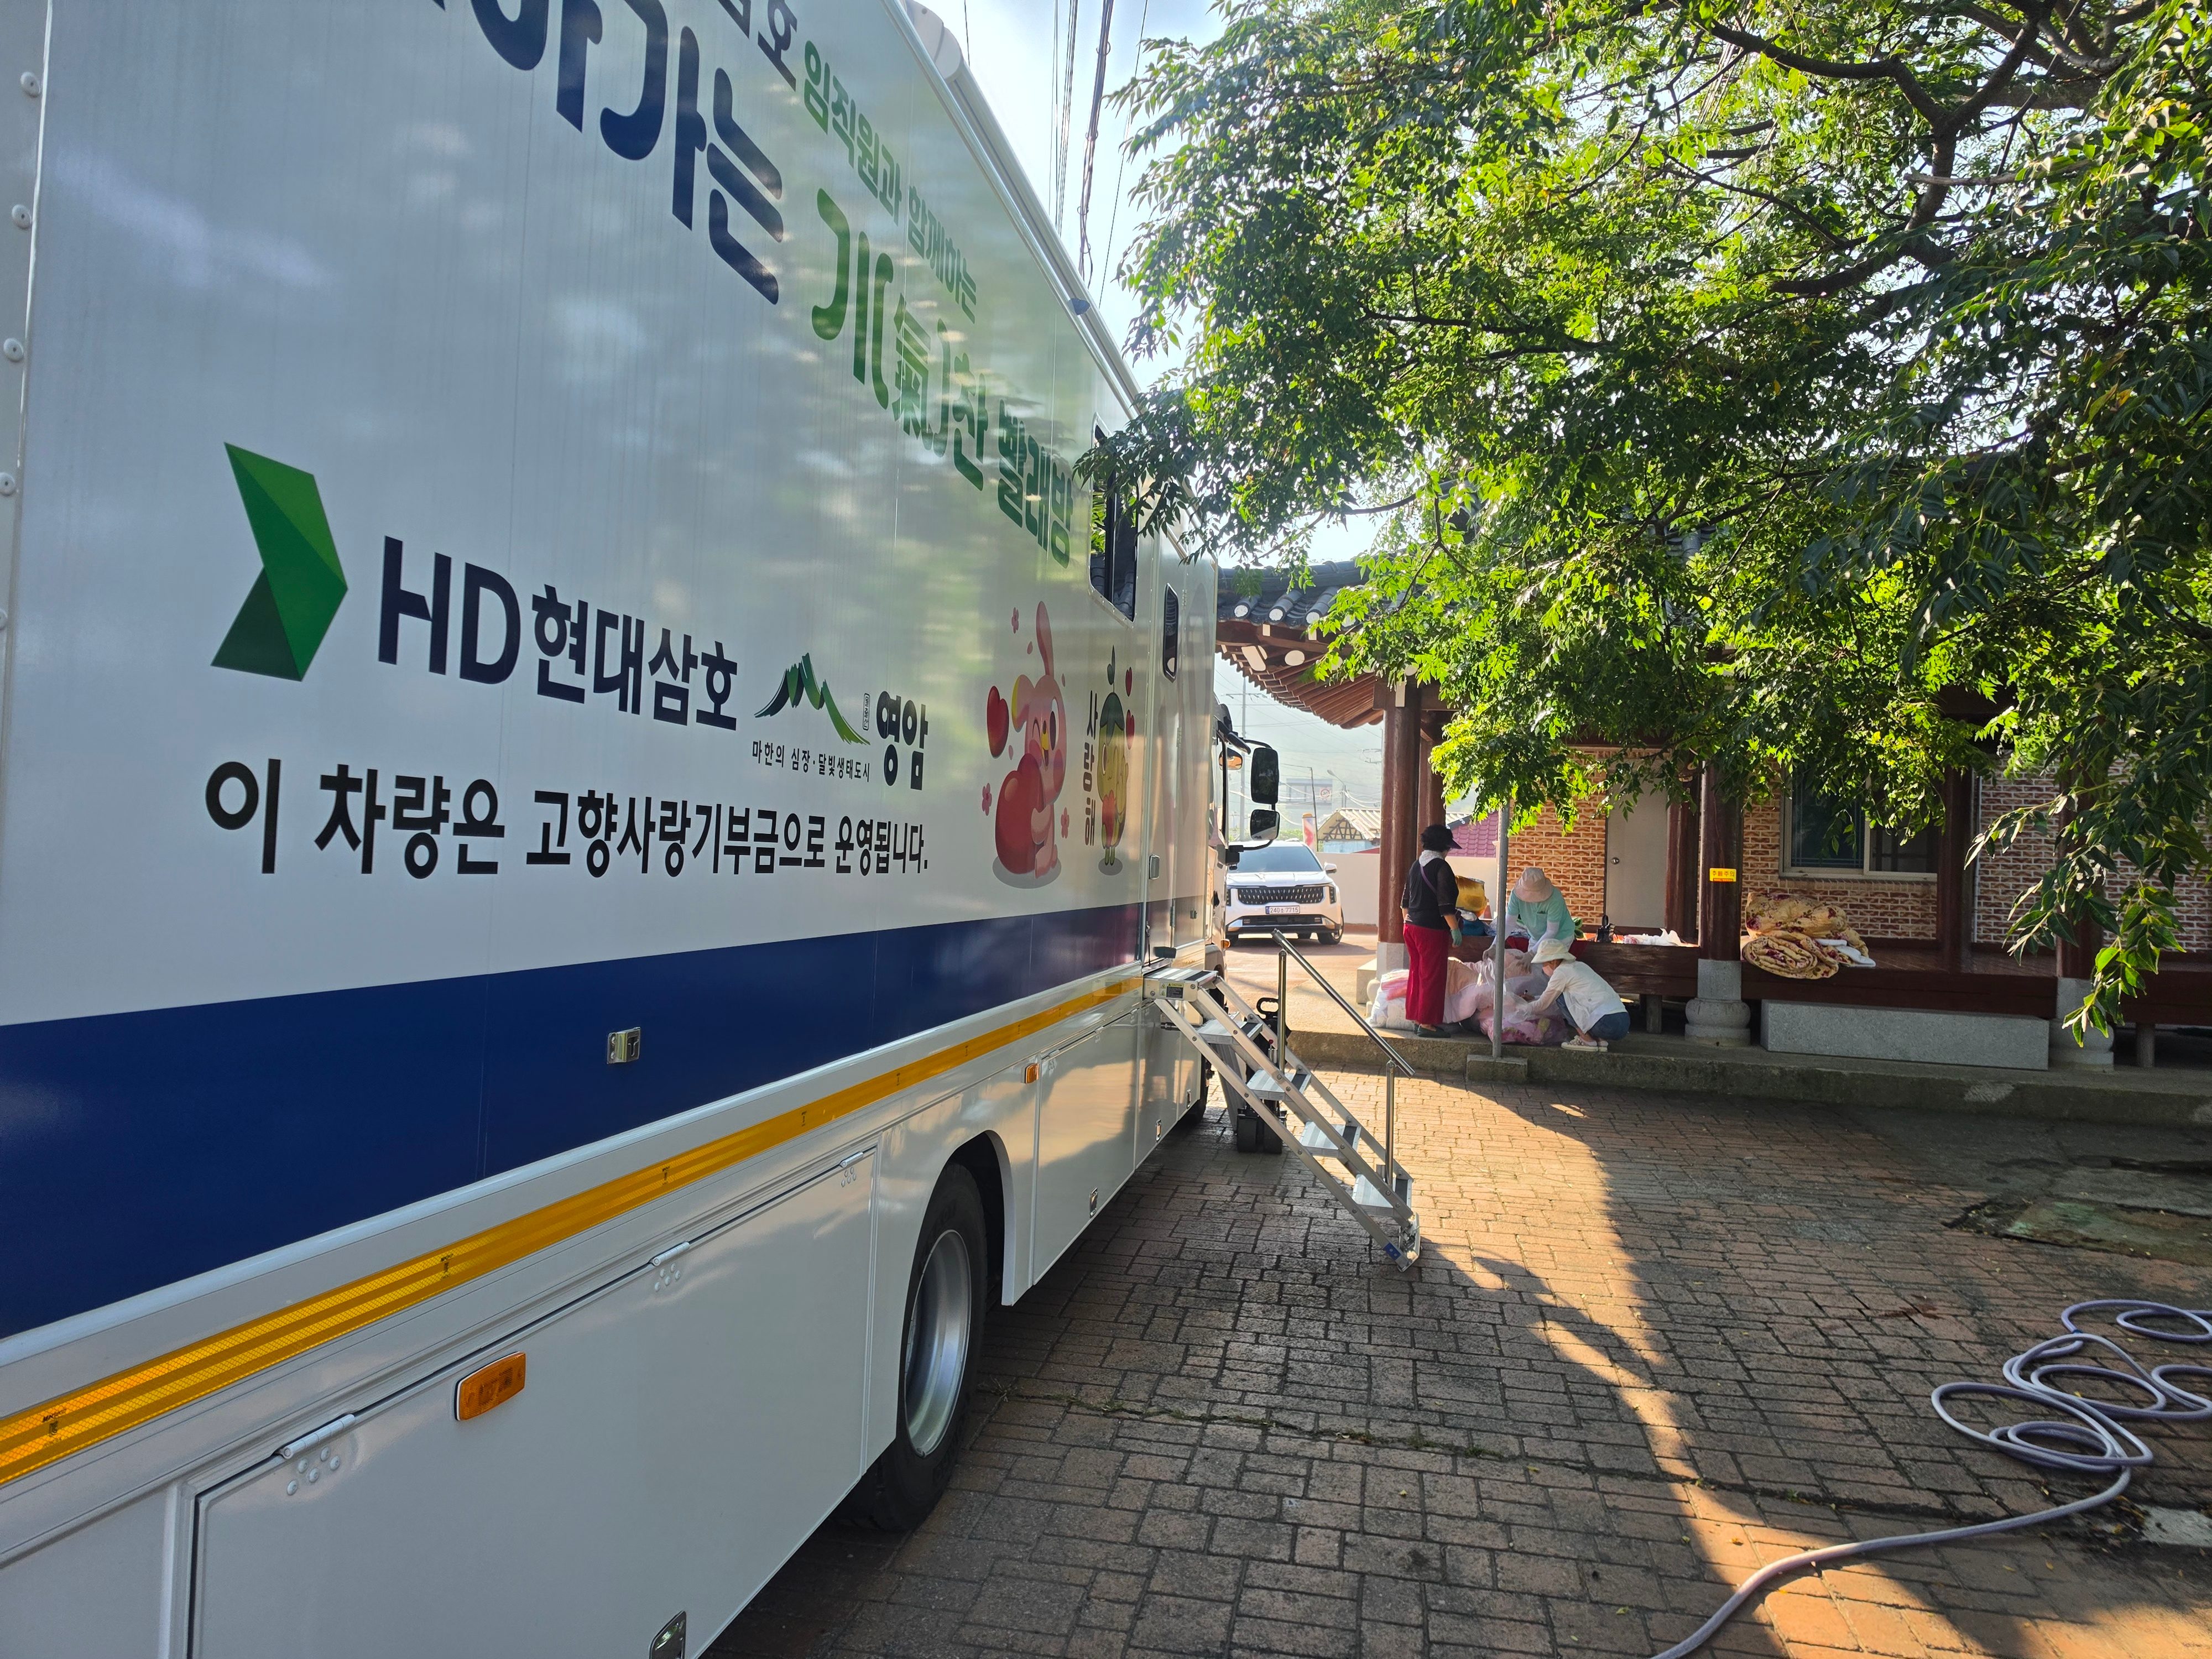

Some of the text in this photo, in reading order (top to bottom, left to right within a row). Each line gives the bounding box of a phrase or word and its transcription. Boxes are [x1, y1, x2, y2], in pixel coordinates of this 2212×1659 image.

[804, 40, 901, 226] 임직원과
[908, 185, 977, 325] 함께하는
[998, 399, 1073, 569] 빨래방
[378, 535, 738, 731] HD현대삼호
[752, 740, 785, 768] 마한의
[876, 690, 928, 791] 영암
[205, 758, 928, 879] 이 차량은 고향사랑기부금으로 운영됩니다.
